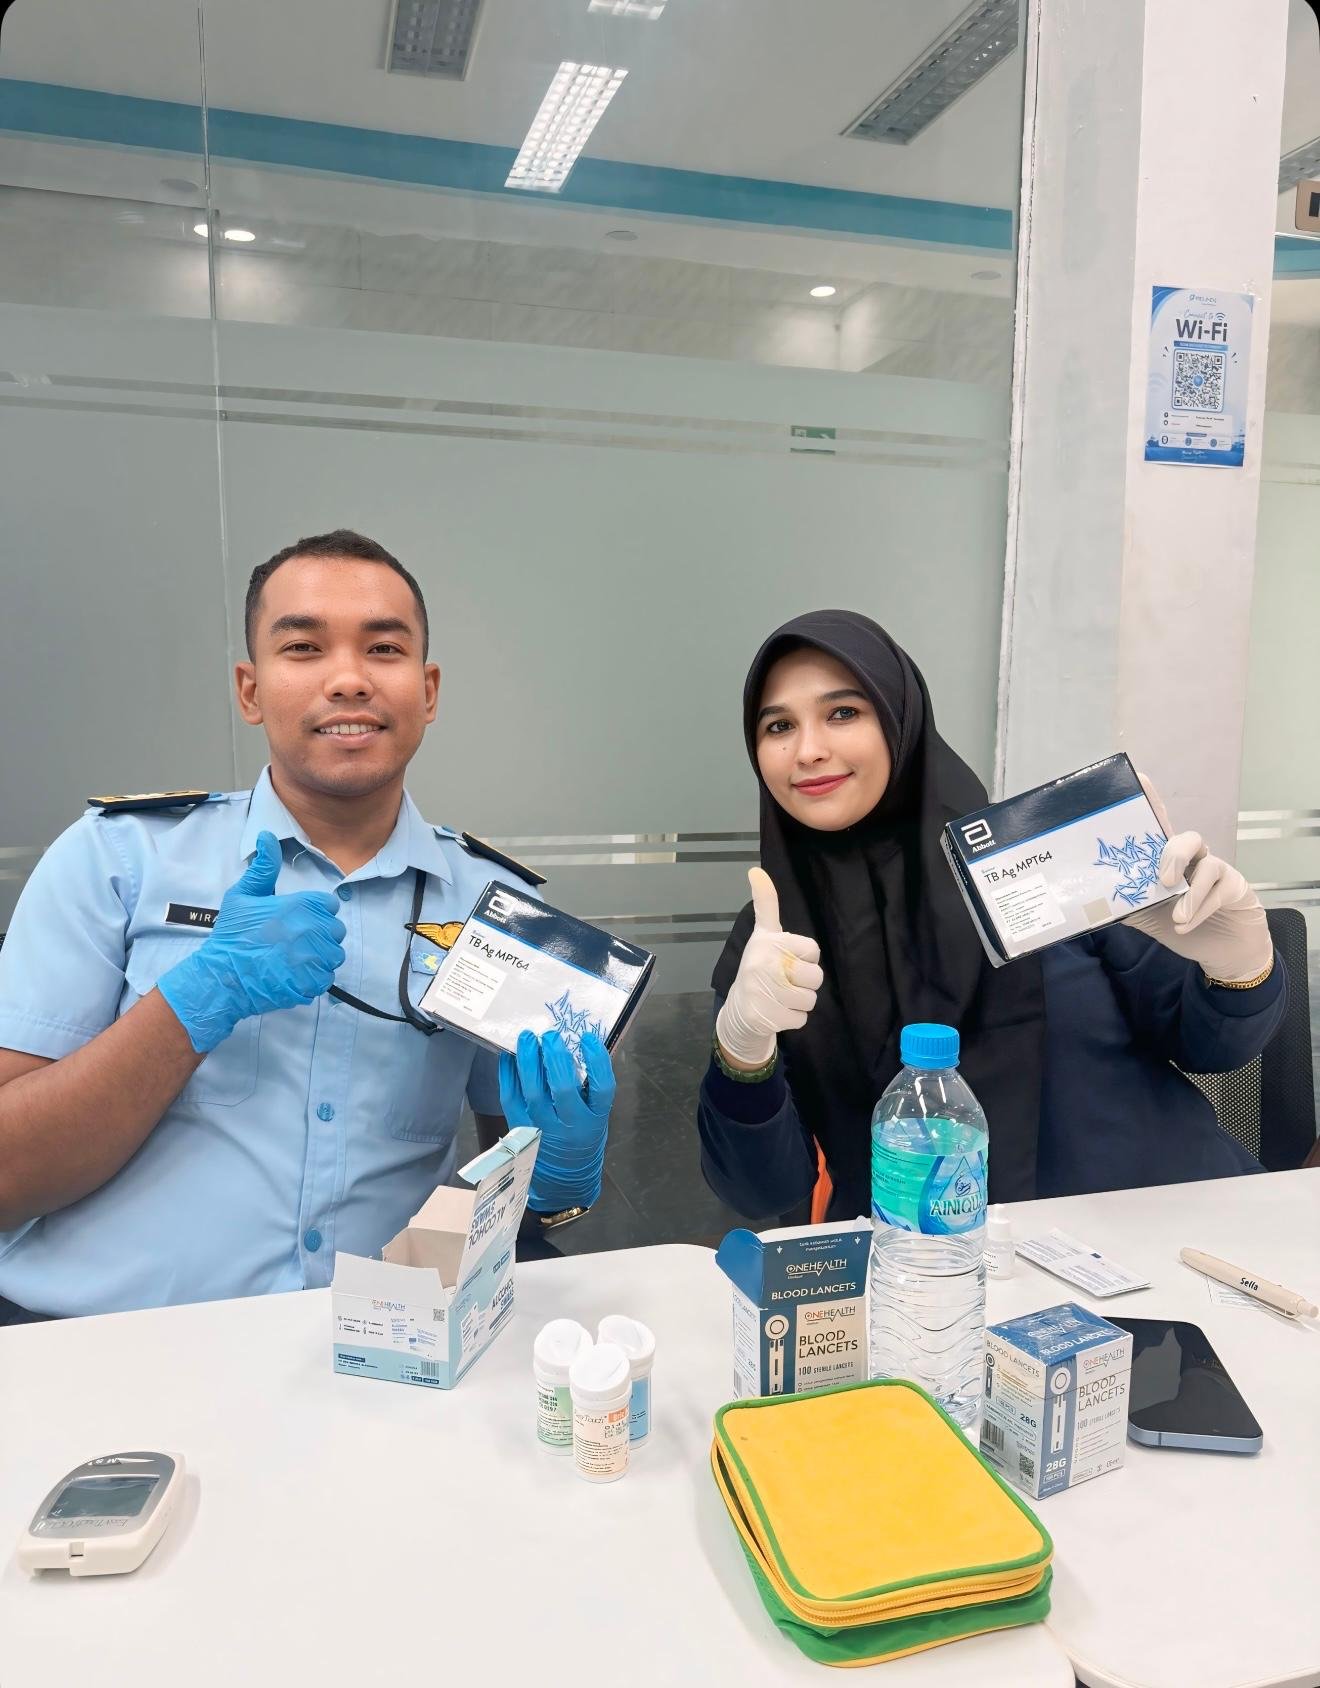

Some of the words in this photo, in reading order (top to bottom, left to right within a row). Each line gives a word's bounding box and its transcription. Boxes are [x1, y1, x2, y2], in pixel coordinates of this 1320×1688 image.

[1176, 319, 1228, 342] Wi-Fi
[972, 840, 996, 853] Abbott
[984, 871, 999, 884] TB
[1002, 869, 1017, 878] Ag
[1016, 851, 1053, 872] MPT64
[469, 935, 482, 948] TB
[481, 943, 495, 958] Ag
[495, 949, 530, 970] MPT64
[786, 1258, 847, 1274] ONEHEALTH
[771, 1288, 809, 1300] BLOOD
[811, 1282, 857, 1295] LANCETS
[1240, 1278, 1258, 1290] Sella
[805, 1306, 856, 1321] ONEHEALTH
[799, 1330, 846, 1346] BLOOD
[798, 1340, 859, 1358] LANCETS
[1040, 1340, 1075, 1355] BLOOD
[986, 1339, 1009, 1359] BLOOD
[1009, 1355, 1040, 1378] LANCETS
[799, 1366, 812, 1376] 100
[1079, 1374, 1117, 1398] BLOOD
[1078, 1384, 1126, 1412] LANCETS
[1020, 1413, 1037, 1428] 28G
[1046, 1458, 1067, 1473] 28G
